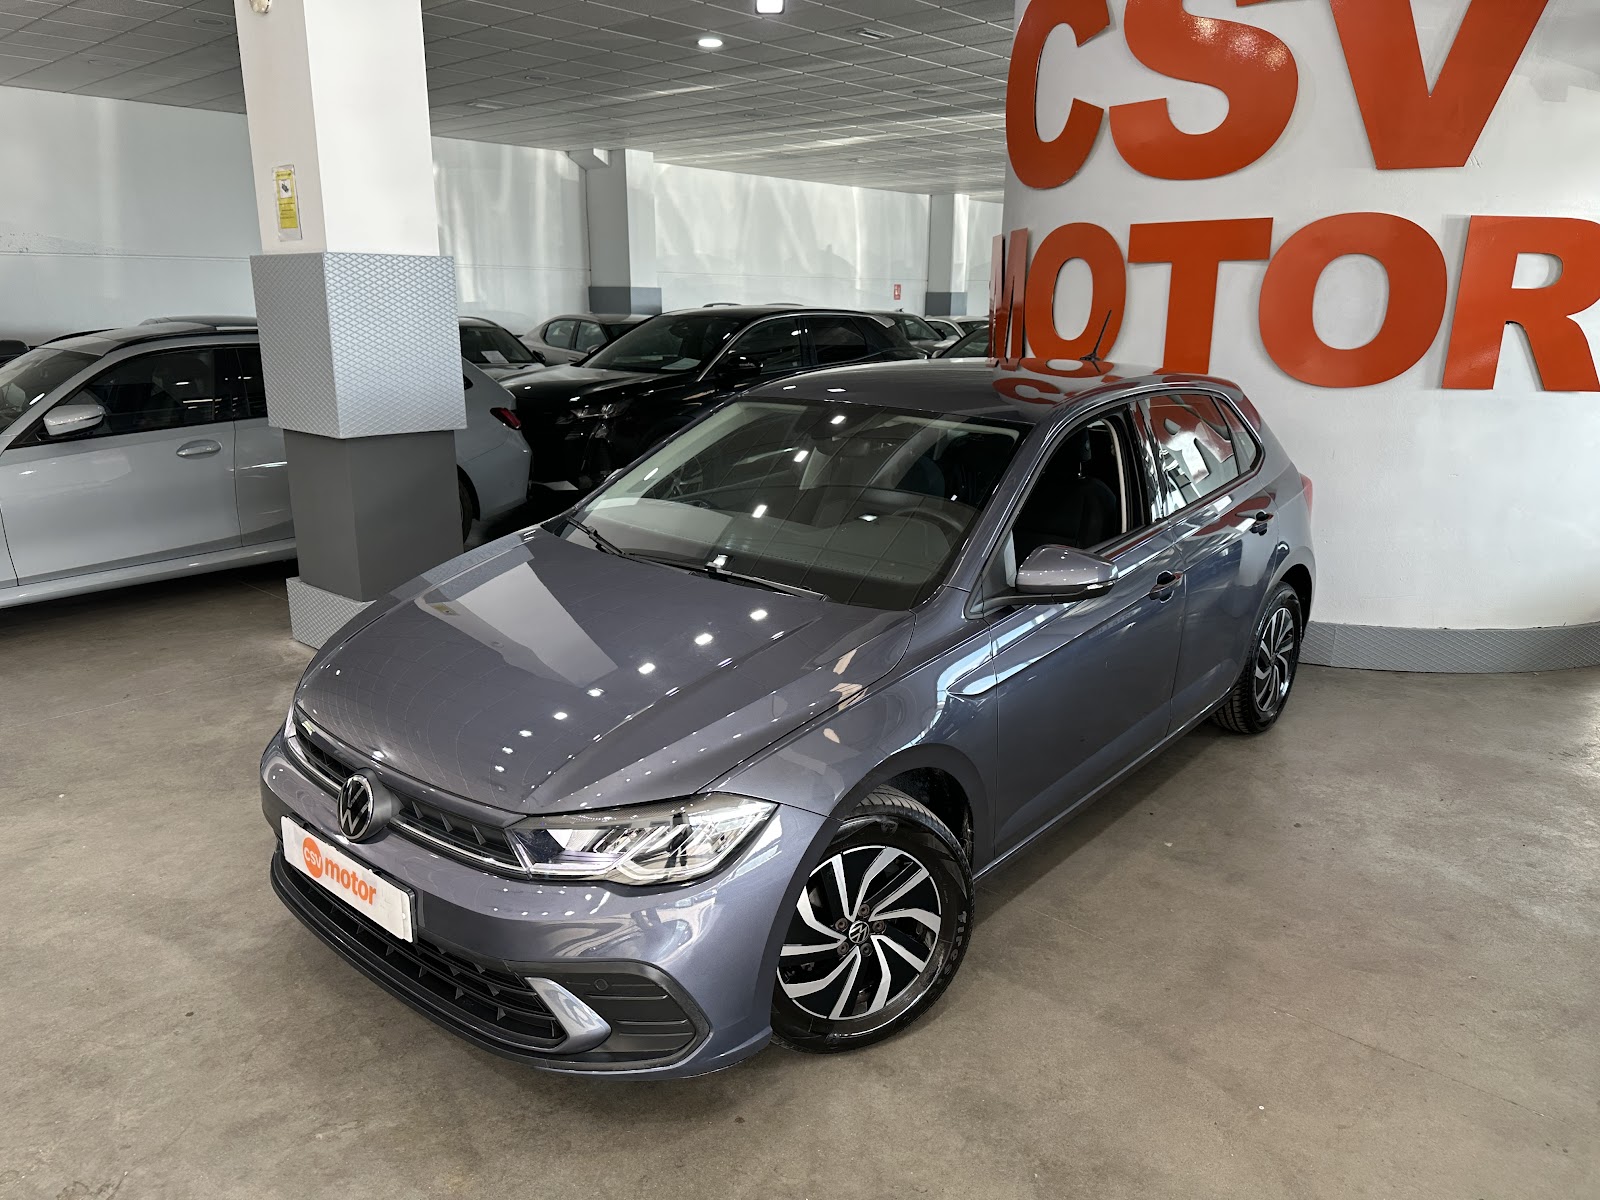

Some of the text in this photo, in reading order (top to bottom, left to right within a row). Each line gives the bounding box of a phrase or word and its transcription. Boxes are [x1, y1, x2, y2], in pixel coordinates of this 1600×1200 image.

[1005, 0, 1549, 189] CSV
[989, 211, 1600, 392] MOTOR
[304, 846, 376, 905] CSV motor
